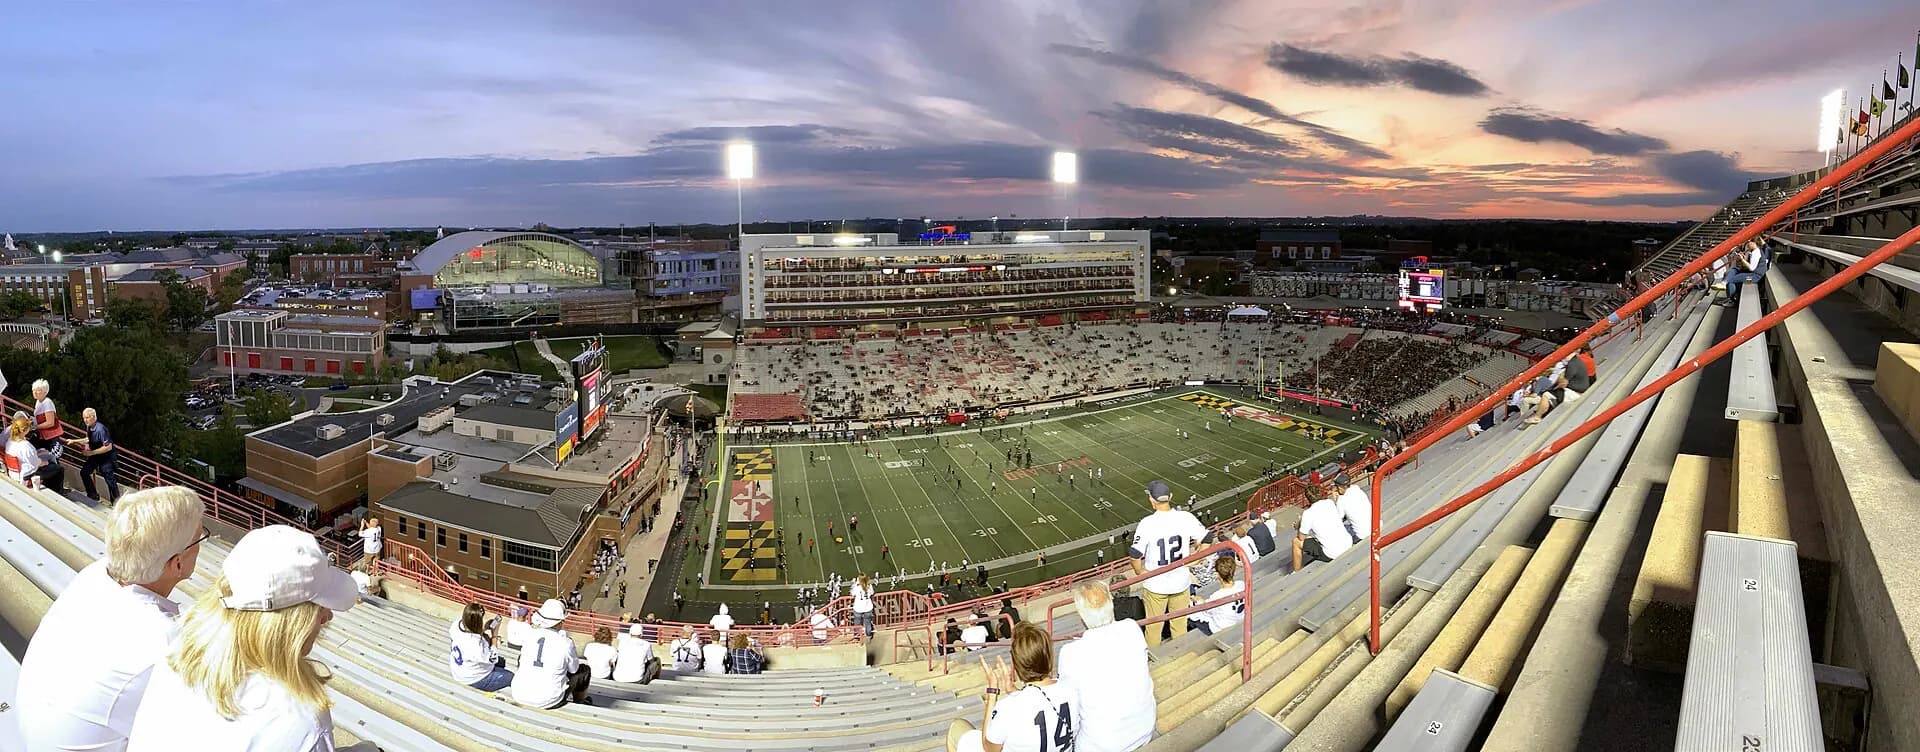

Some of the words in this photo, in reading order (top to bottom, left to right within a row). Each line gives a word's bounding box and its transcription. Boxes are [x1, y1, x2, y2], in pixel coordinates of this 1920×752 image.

[1157, 535, 1183, 566] 12
[1744, 579, 1757, 590] 24
[533, 637, 545, 667] 1
[1034, 701, 1073, 752] 14
